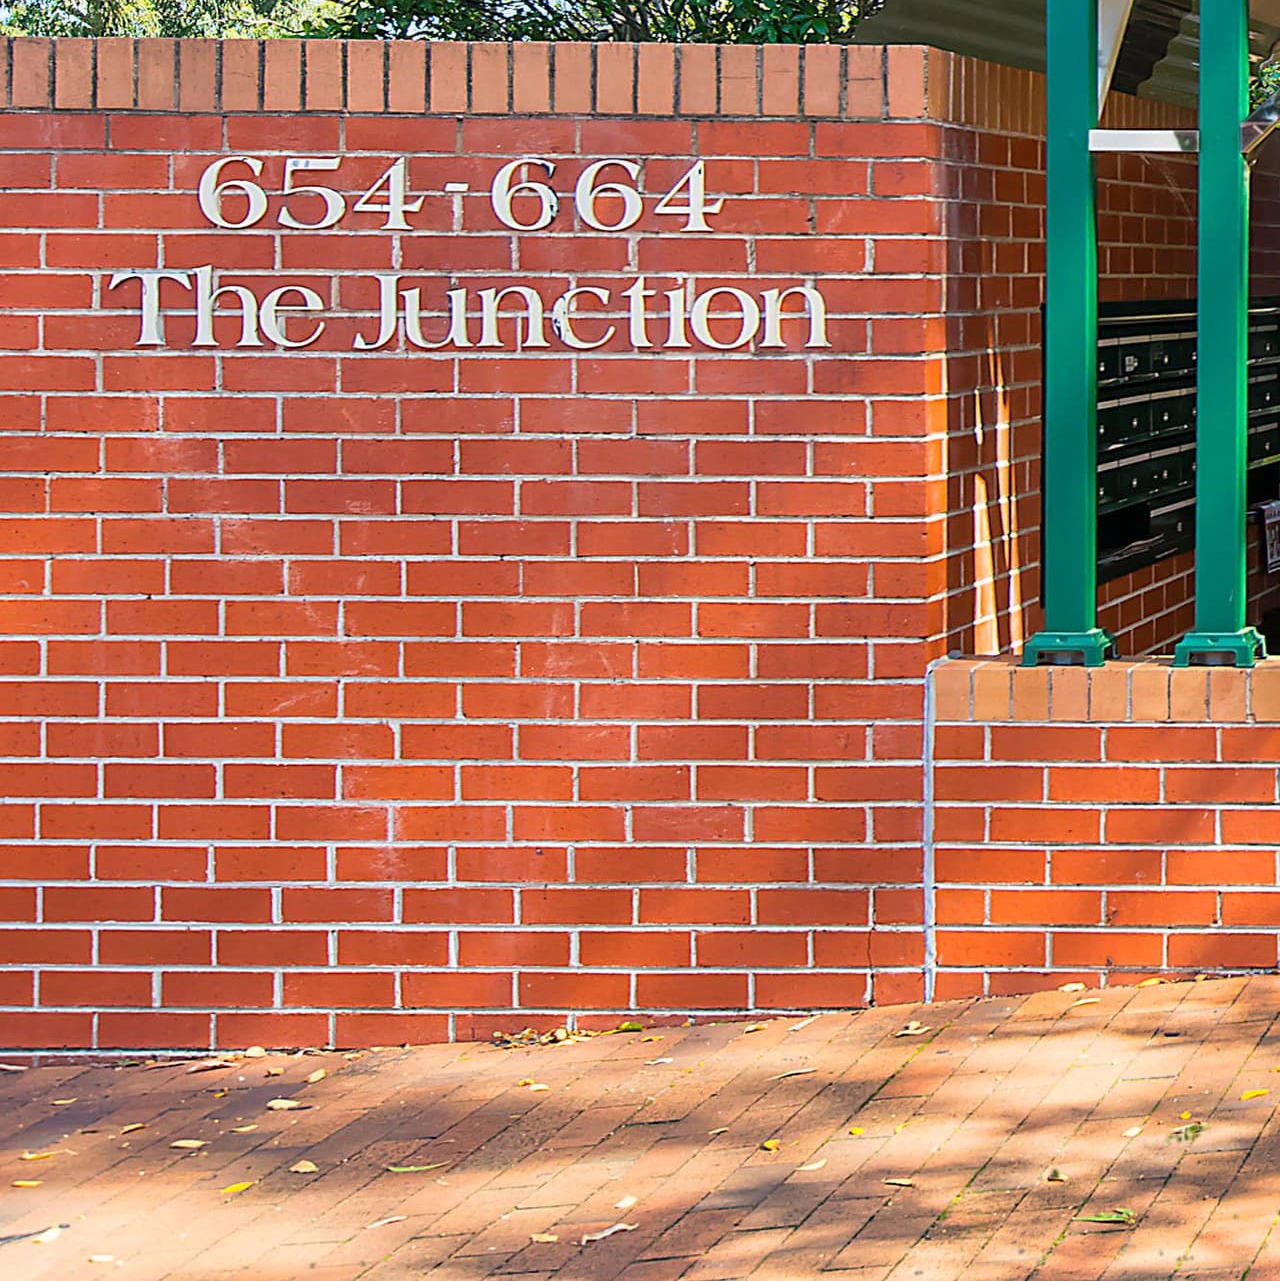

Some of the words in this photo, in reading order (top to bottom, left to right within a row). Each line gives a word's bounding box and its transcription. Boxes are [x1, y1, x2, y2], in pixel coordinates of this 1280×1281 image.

[197, 155, 725, 233] 654-664
[108, 264, 326, 349] The
[352, 274, 832, 350] Junction
